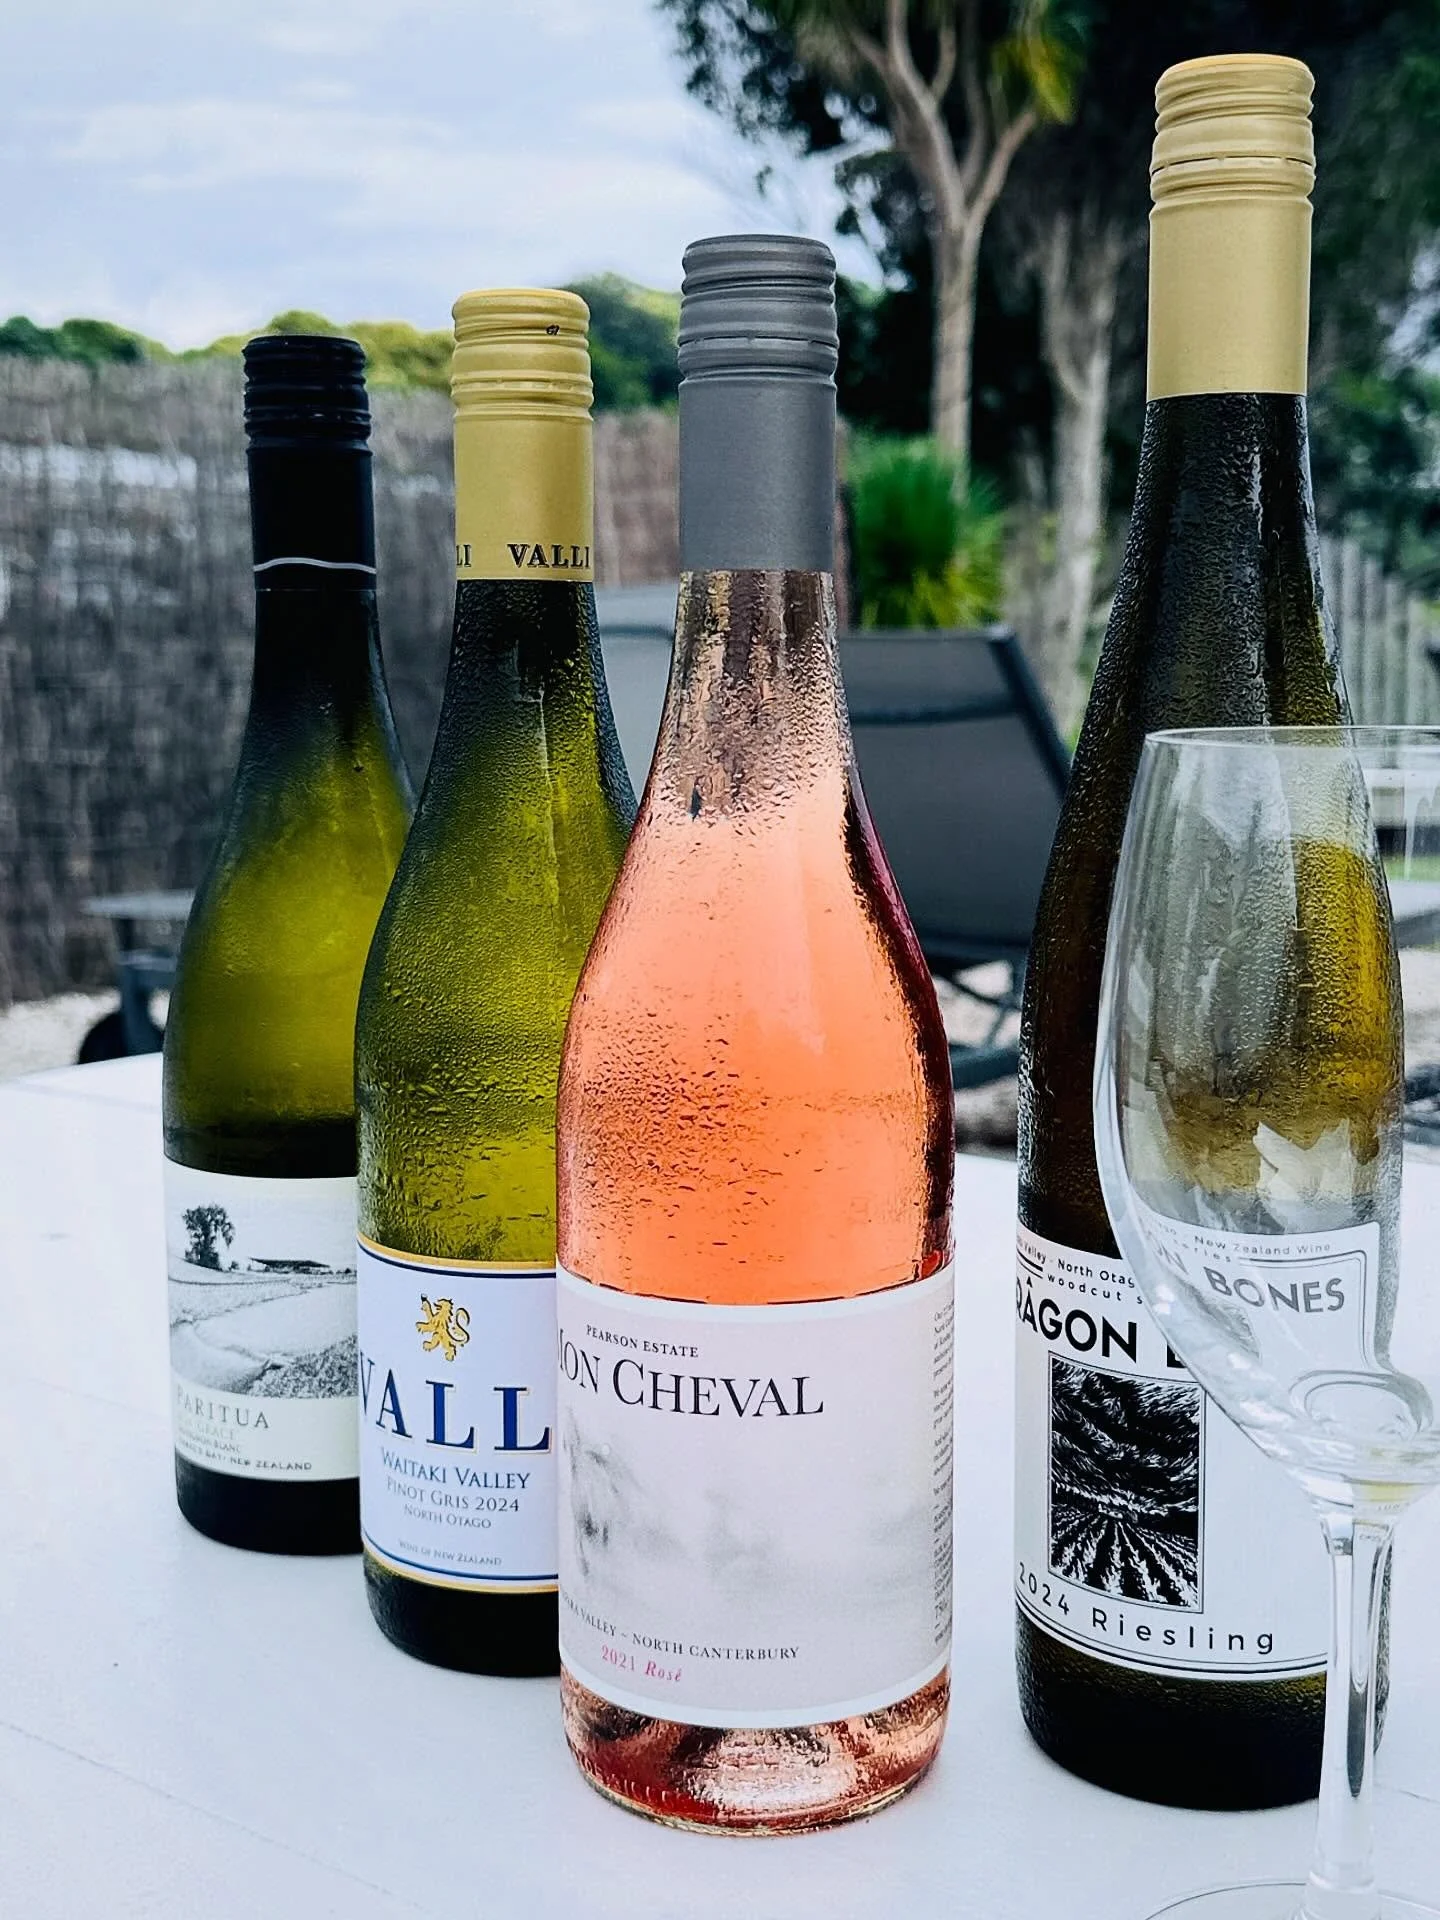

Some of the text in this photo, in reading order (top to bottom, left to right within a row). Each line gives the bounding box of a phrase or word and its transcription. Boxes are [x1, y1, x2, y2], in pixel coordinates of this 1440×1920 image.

[506, 543, 590, 569] VALLI
[1194, 1234, 1226, 1250] New
[1047, 1274, 1122, 1301] woodcut
[1057, 1258, 1093, 1278] North
[1099, 1270, 1136, 1289] Otag
[1204, 1266, 1345, 1313] BONES
[586, 1324, 699, 1358] PEARSON ESTATE
[360, 1349, 551, 1452] VALL
[612, 1358, 824, 1418] CHEVAL
[176, 1384, 269, 1429] PARITUA
[230, 1456, 252, 1466] NEW
[256, 1460, 312, 1471] ZEALAND
[381, 1446, 530, 1489] WAITAKI VALLEY
[386, 1476, 520, 1512] PINOT GRIS 2024
[404, 1503, 491, 1529] NORTH OTAGO
[398, 1538, 418, 1553] WINE
[433, 1549, 456, 1561] NEW
[457, 1552, 502, 1566] ZEALAND
[1019, 1561, 1274, 1655] 2024 Riesling
[580, 1607, 616, 1637] VALLEY
[632, 1633, 683, 1655] NORTH
[689, 1646, 800, 1660] CANTERBURY
[602, 1643, 682, 1682] 2021 Rosé
